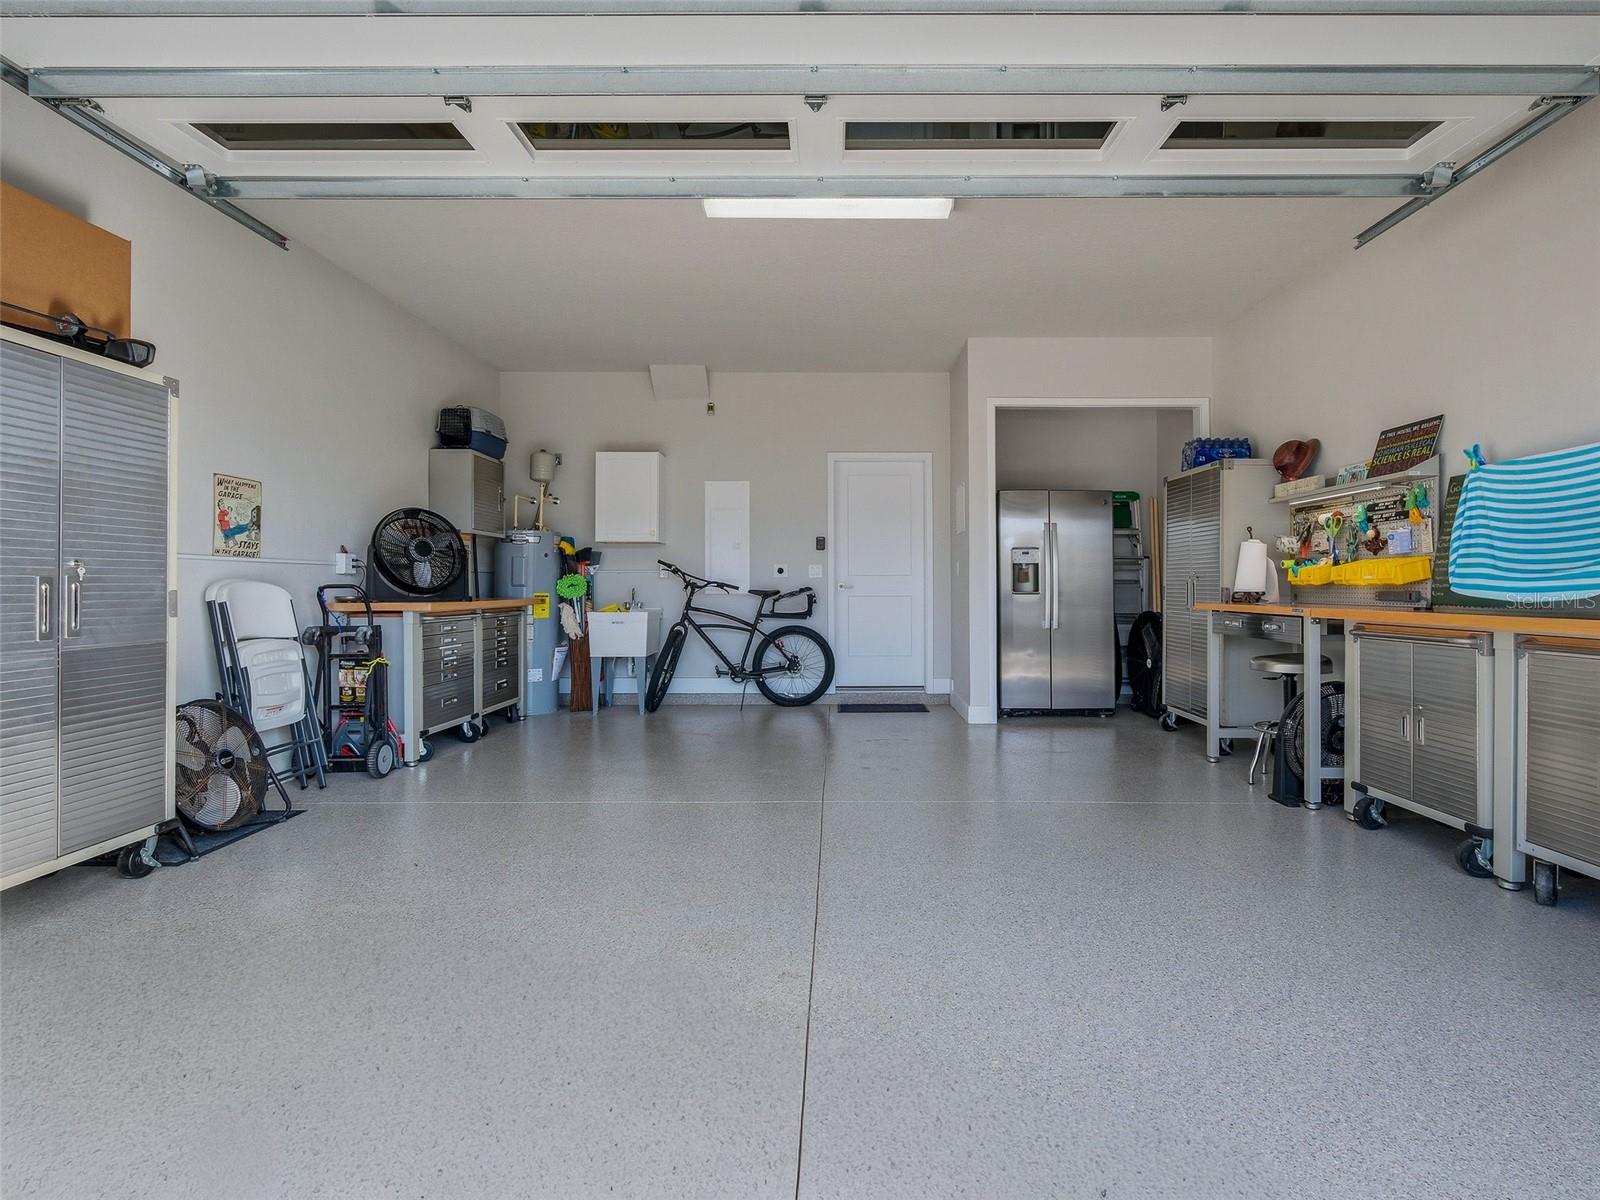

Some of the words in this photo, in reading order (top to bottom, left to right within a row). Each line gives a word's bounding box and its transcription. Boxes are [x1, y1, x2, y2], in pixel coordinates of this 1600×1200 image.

[1373, 452, 1402, 466] SCIENCE
[1402, 451, 1410, 460] IS
[1411, 446, 1430, 456] REAL
[217, 477, 234, 486] WHAT
[218, 491, 244, 500] GARAGE
[238, 540, 259, 550] STAYS
[232, 550, 259, 559] GARAGE!
